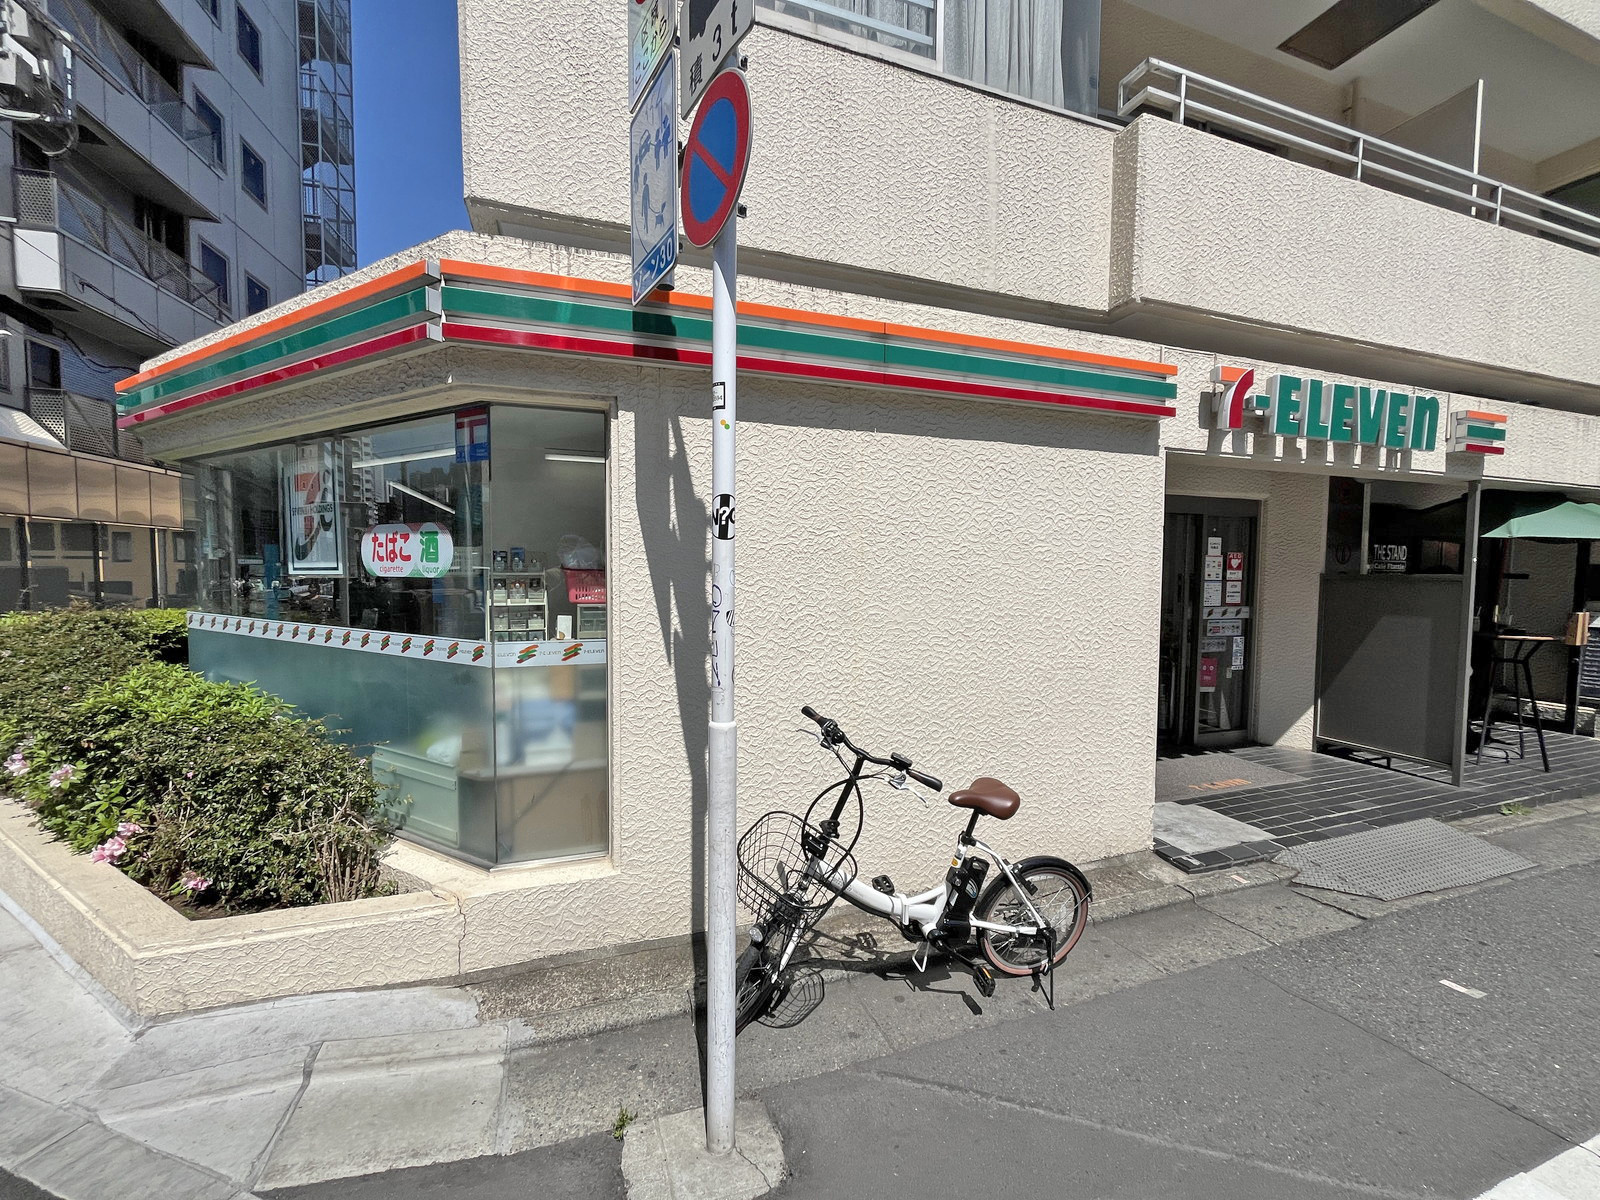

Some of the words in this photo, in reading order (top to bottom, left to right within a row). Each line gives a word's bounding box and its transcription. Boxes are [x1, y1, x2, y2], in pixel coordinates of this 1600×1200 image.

[635, 15, 667, 85] ここから
[634, 236, 673, 297] ゾーン30
[371, 530, 412, 563] たばこ
[419, 530, 439, 563] 酒
[1373, 544, 1387, 560] THE
[1387, 544, 1408, 561] STAND
[379, 564, 404, 574] cigarette
[422, 565, 440, 574] liquor
